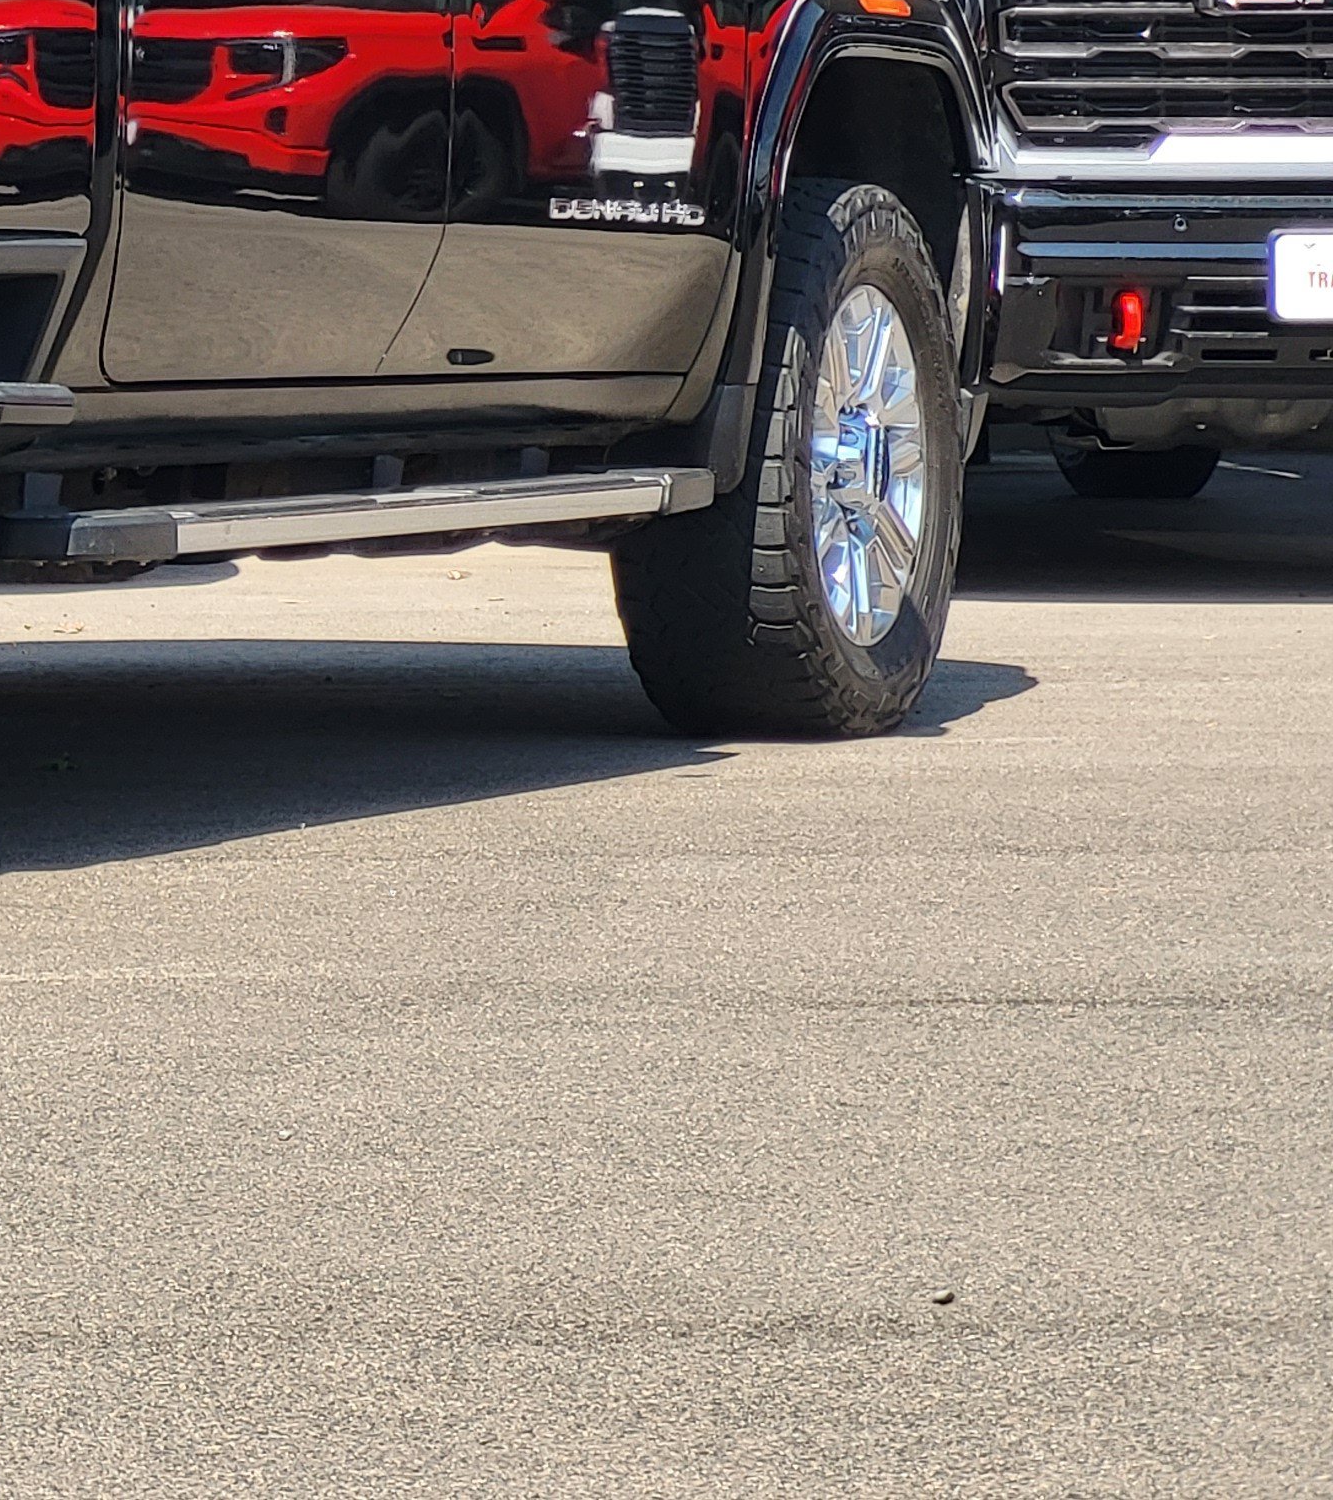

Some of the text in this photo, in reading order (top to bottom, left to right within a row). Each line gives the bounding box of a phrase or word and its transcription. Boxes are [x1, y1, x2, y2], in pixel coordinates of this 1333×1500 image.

[550, 197, 705, 226] DENALI HD
[1308, 271, 1333, 289] TR
